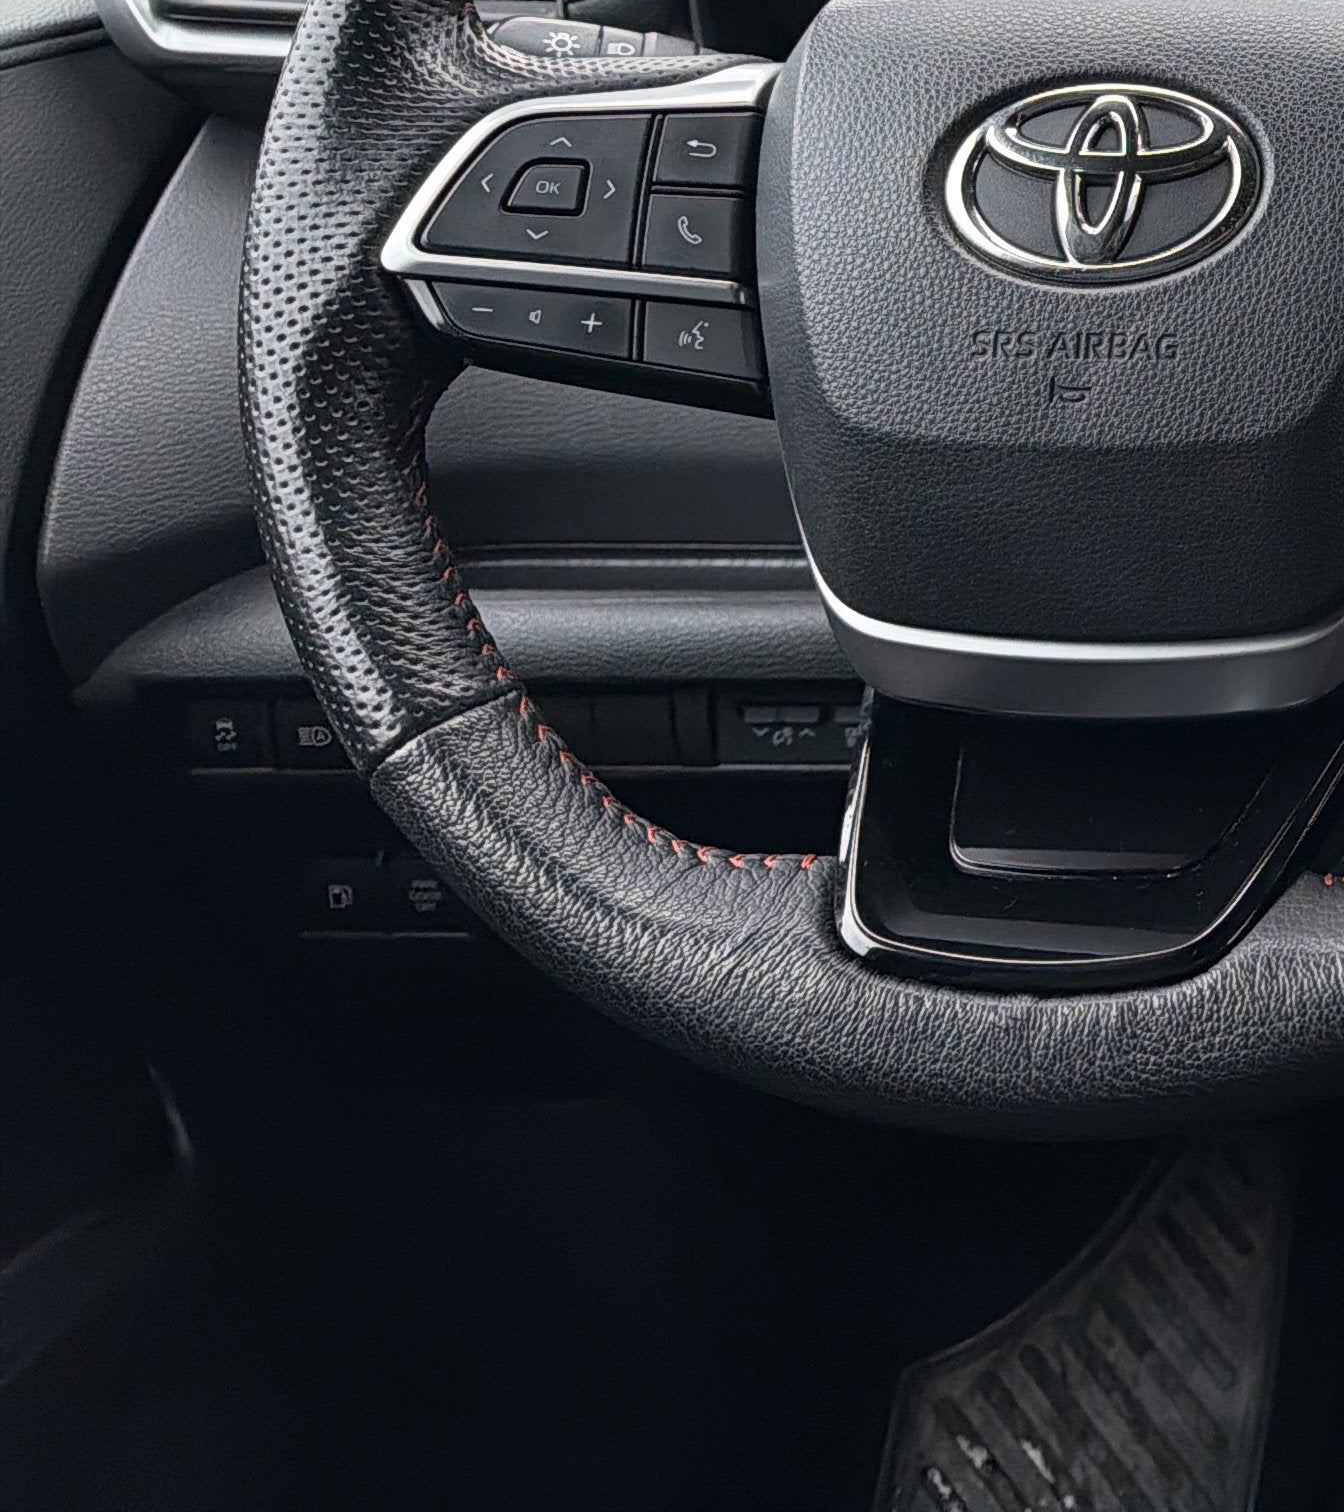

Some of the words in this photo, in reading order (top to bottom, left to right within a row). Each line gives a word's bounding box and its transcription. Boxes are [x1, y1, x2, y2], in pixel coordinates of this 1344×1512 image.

[535, 181, 561, 195] OK
[970, 330, 1036, 359] SRS
[1046, 331, 1178, 360] AIRBAG
